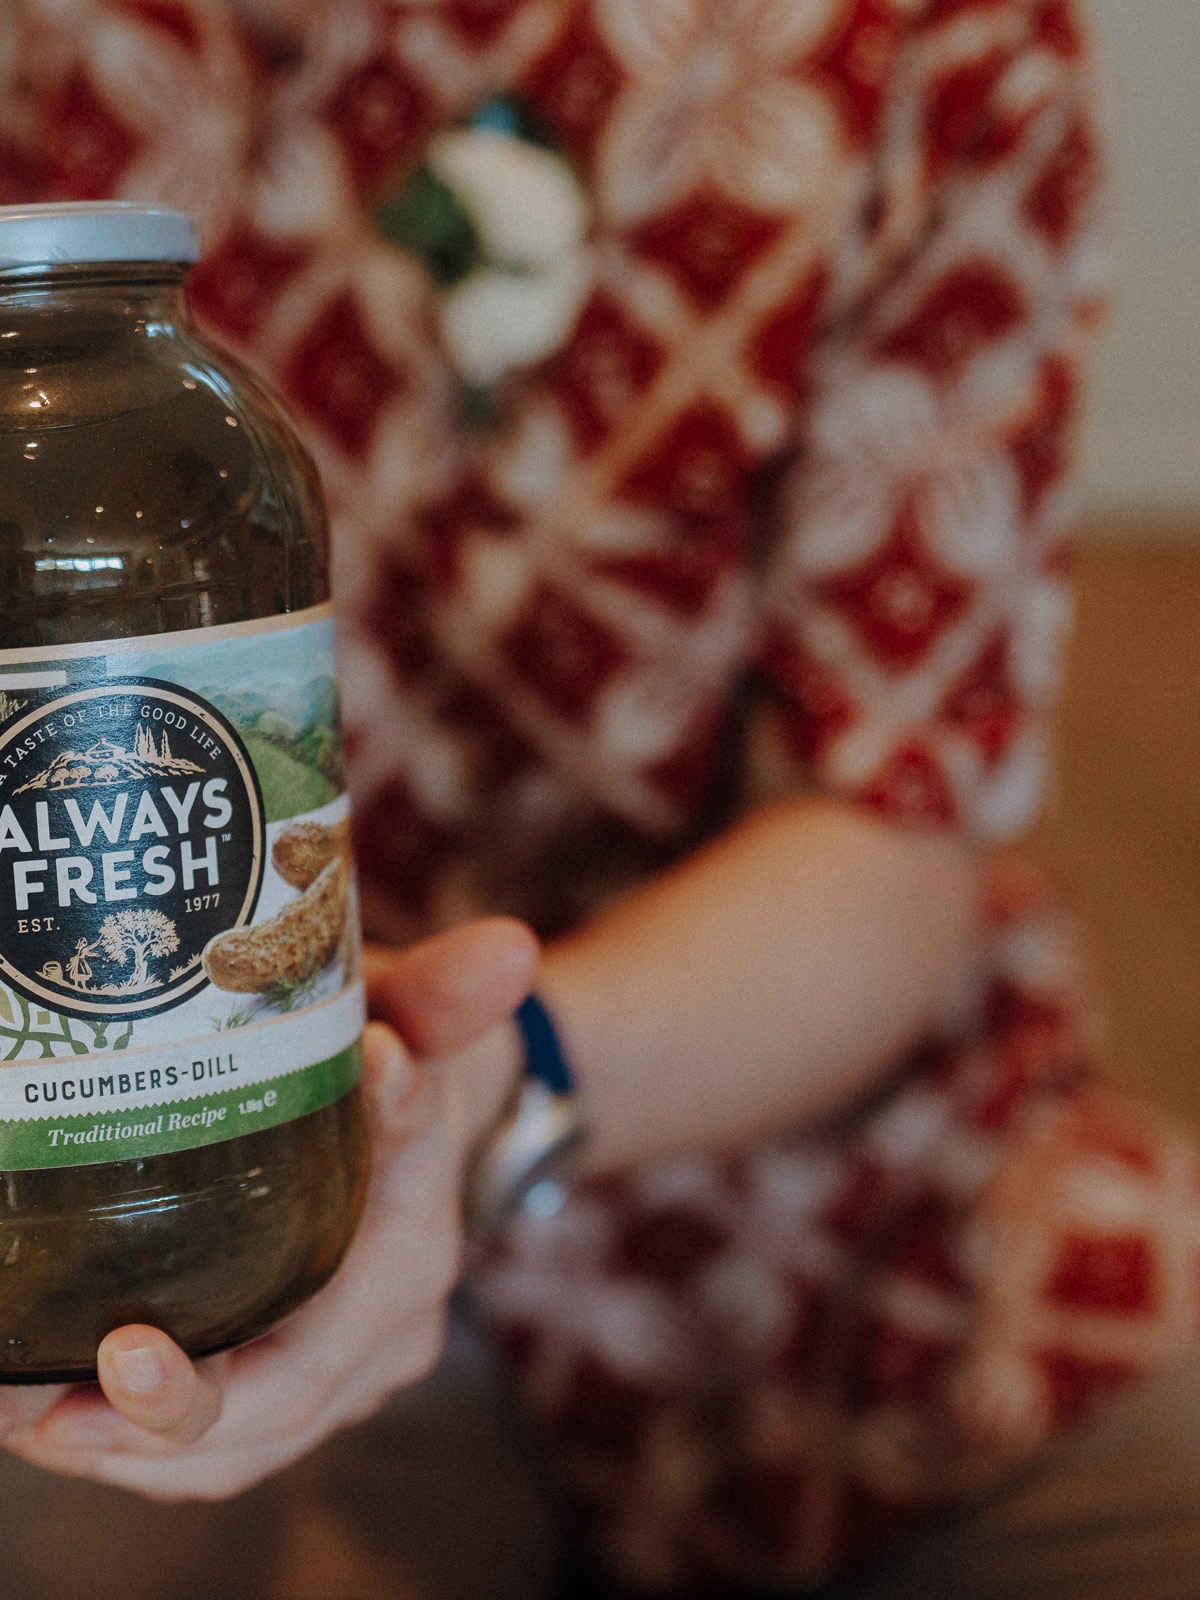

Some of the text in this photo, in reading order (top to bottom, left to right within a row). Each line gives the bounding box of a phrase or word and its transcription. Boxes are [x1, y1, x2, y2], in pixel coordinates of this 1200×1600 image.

[4, 723, 59, 768] TASTE
[63, 709, 87, 728] OF
[98, 703, 132, 718] THE
[140, 705, 187, 730] GOOD
[189, 725, 222, 760] LIFE
[13, 836, 220, 911] FRESH
[17, 917, 61, 934] EST.
[184, 893, 221, 913] 1977
[24, 1053, 239, 1104] CUCUMBERS-DILL
[47, 1115, 164, 1147] Traditional
[167, 1105, 227, 1131] Recipe
